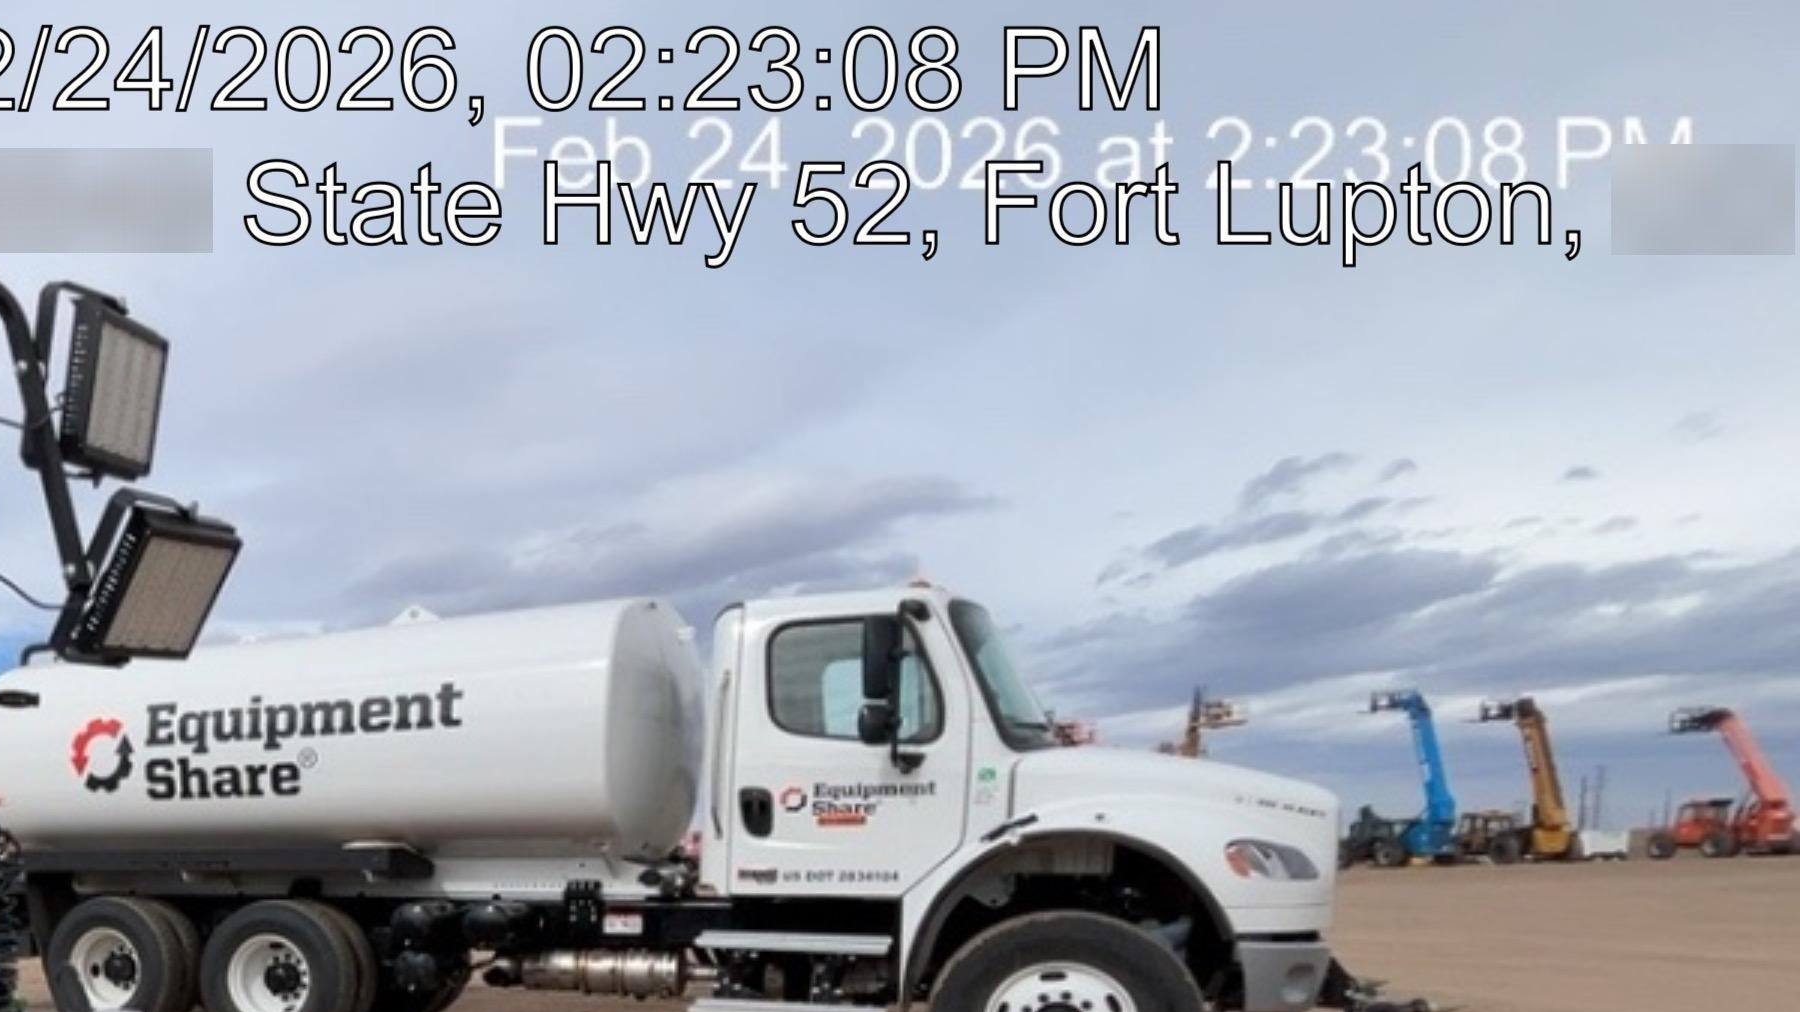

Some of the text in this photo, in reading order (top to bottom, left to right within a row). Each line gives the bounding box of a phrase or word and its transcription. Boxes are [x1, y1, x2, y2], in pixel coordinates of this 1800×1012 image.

[145, 682, 463, 754] Equipment
[812, 781, 936, 800] Equipment
[811, 800, 876, 817] Share
[806, 869, 834, 882] DOT
